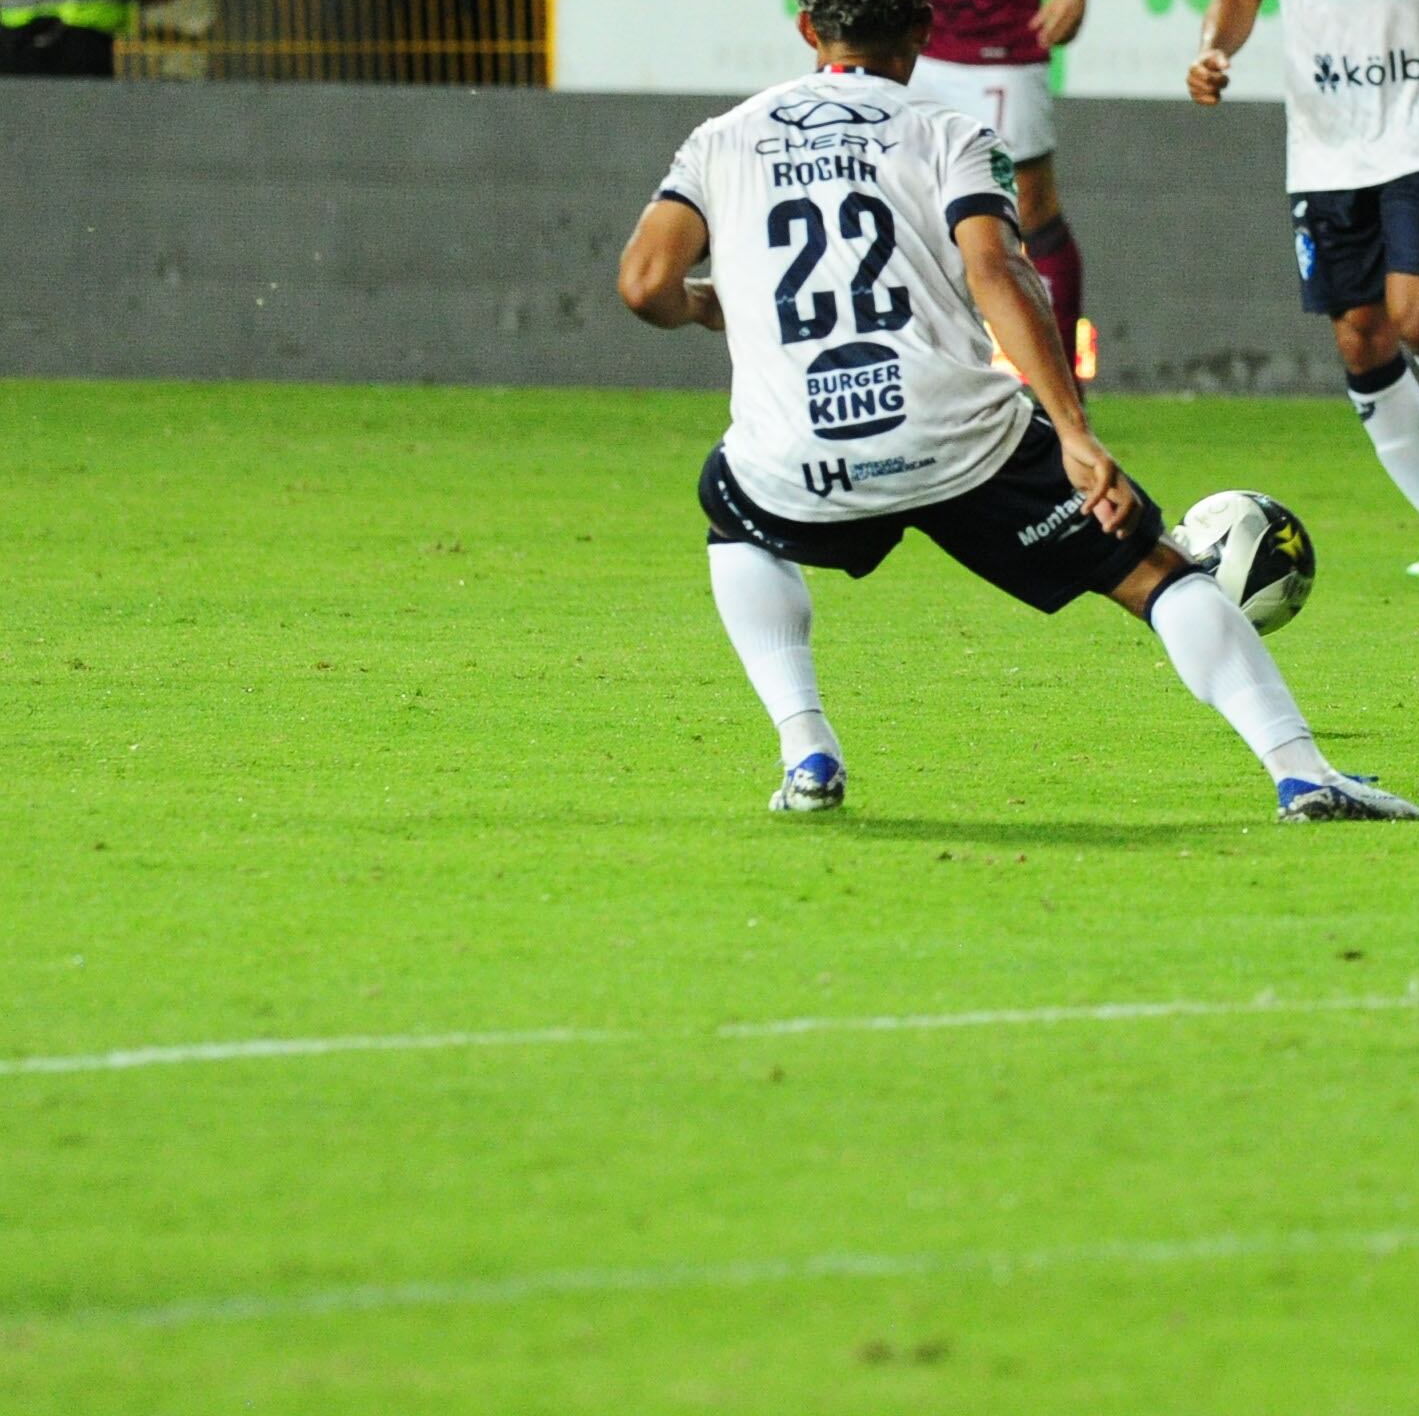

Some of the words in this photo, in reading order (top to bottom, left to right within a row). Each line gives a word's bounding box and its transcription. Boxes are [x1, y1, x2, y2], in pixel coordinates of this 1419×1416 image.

[754, 131, 900, 156] CHERY
[773, 154, 878, 187] ROCHA
[767, 191, 913, 345] 22
[806, 362, 901, 396] BURGER
[809, 384, 905, 426] KING
[802, 456, 853, 497] UH
